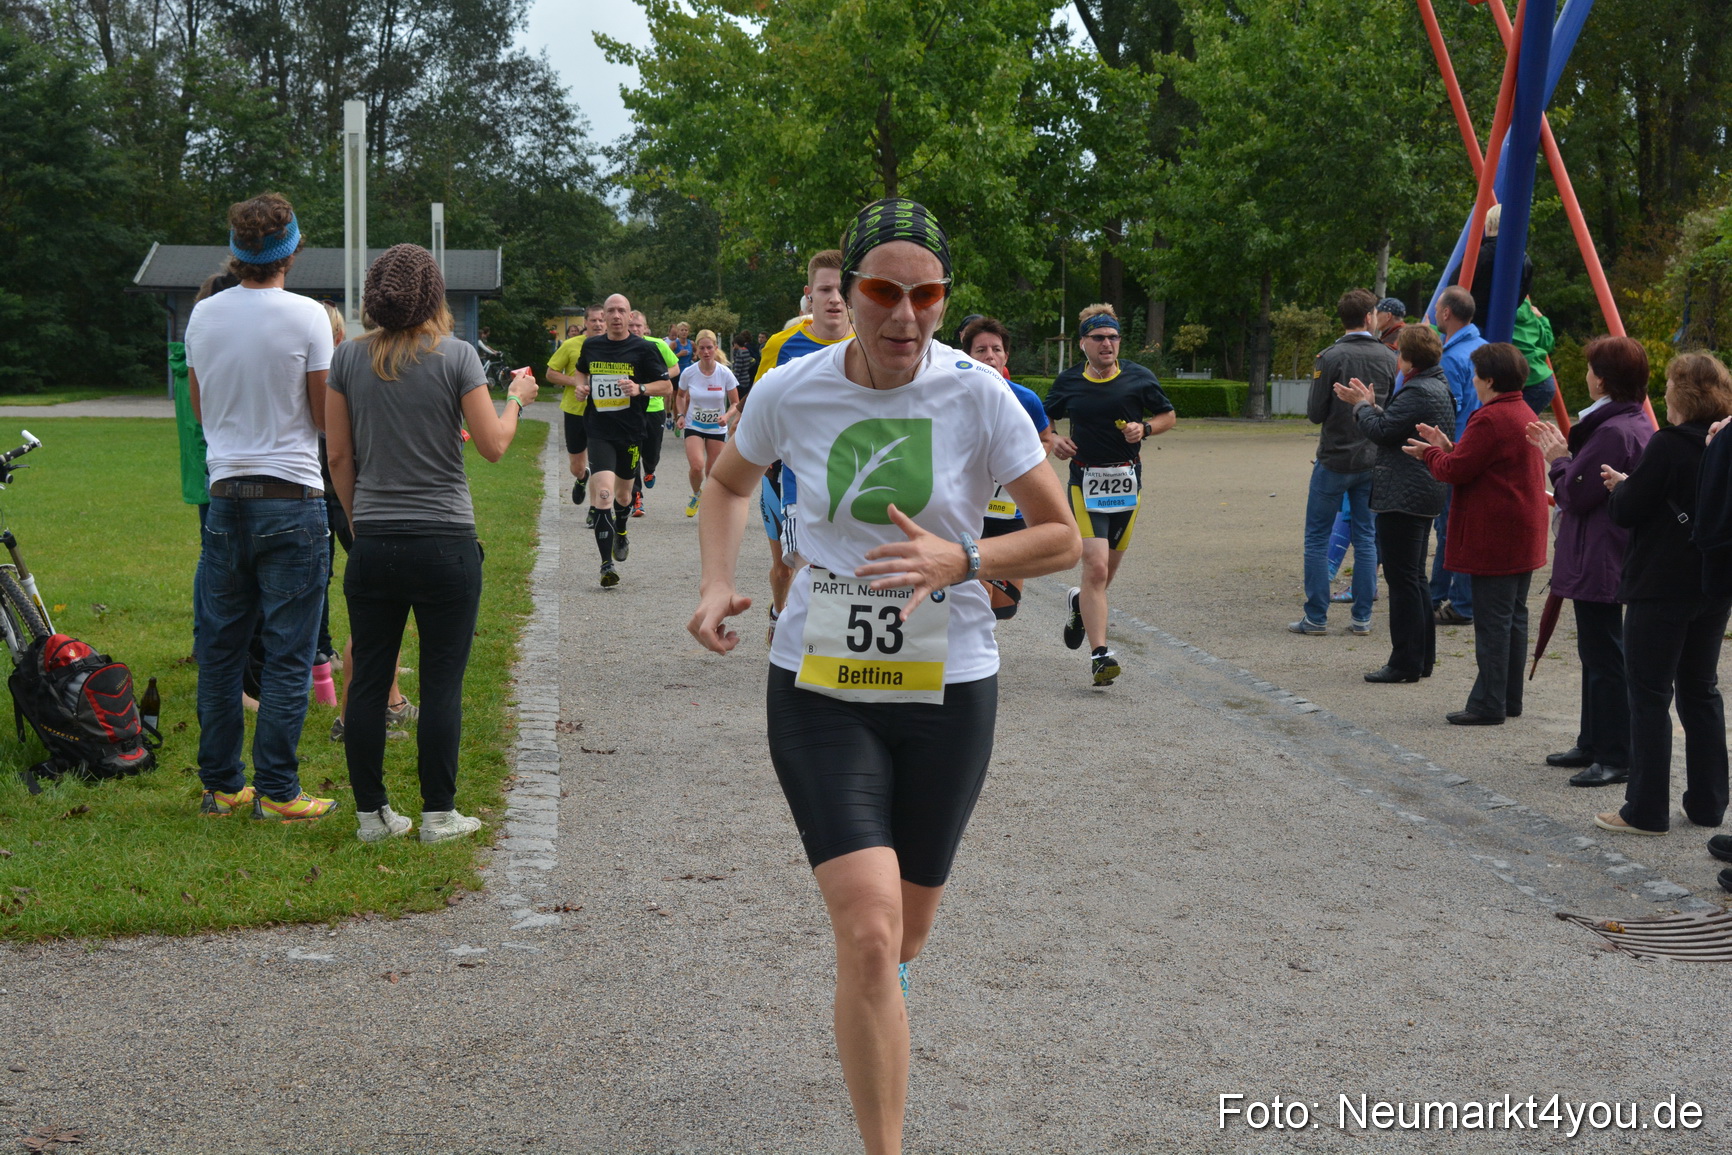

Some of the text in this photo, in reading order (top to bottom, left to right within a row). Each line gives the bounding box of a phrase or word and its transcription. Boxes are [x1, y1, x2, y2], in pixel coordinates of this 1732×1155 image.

[598, 384, 622, 398] 615
[695, 411, 719, 423] 3322
[1088, 478, 1133, 496] 2429
[1097, 499, 1126, 507] Andreas
[813, 582, 854, 596] PARTL
[847, 604, 904, 654] 53
[838, 665, 903, 686] Bettina
